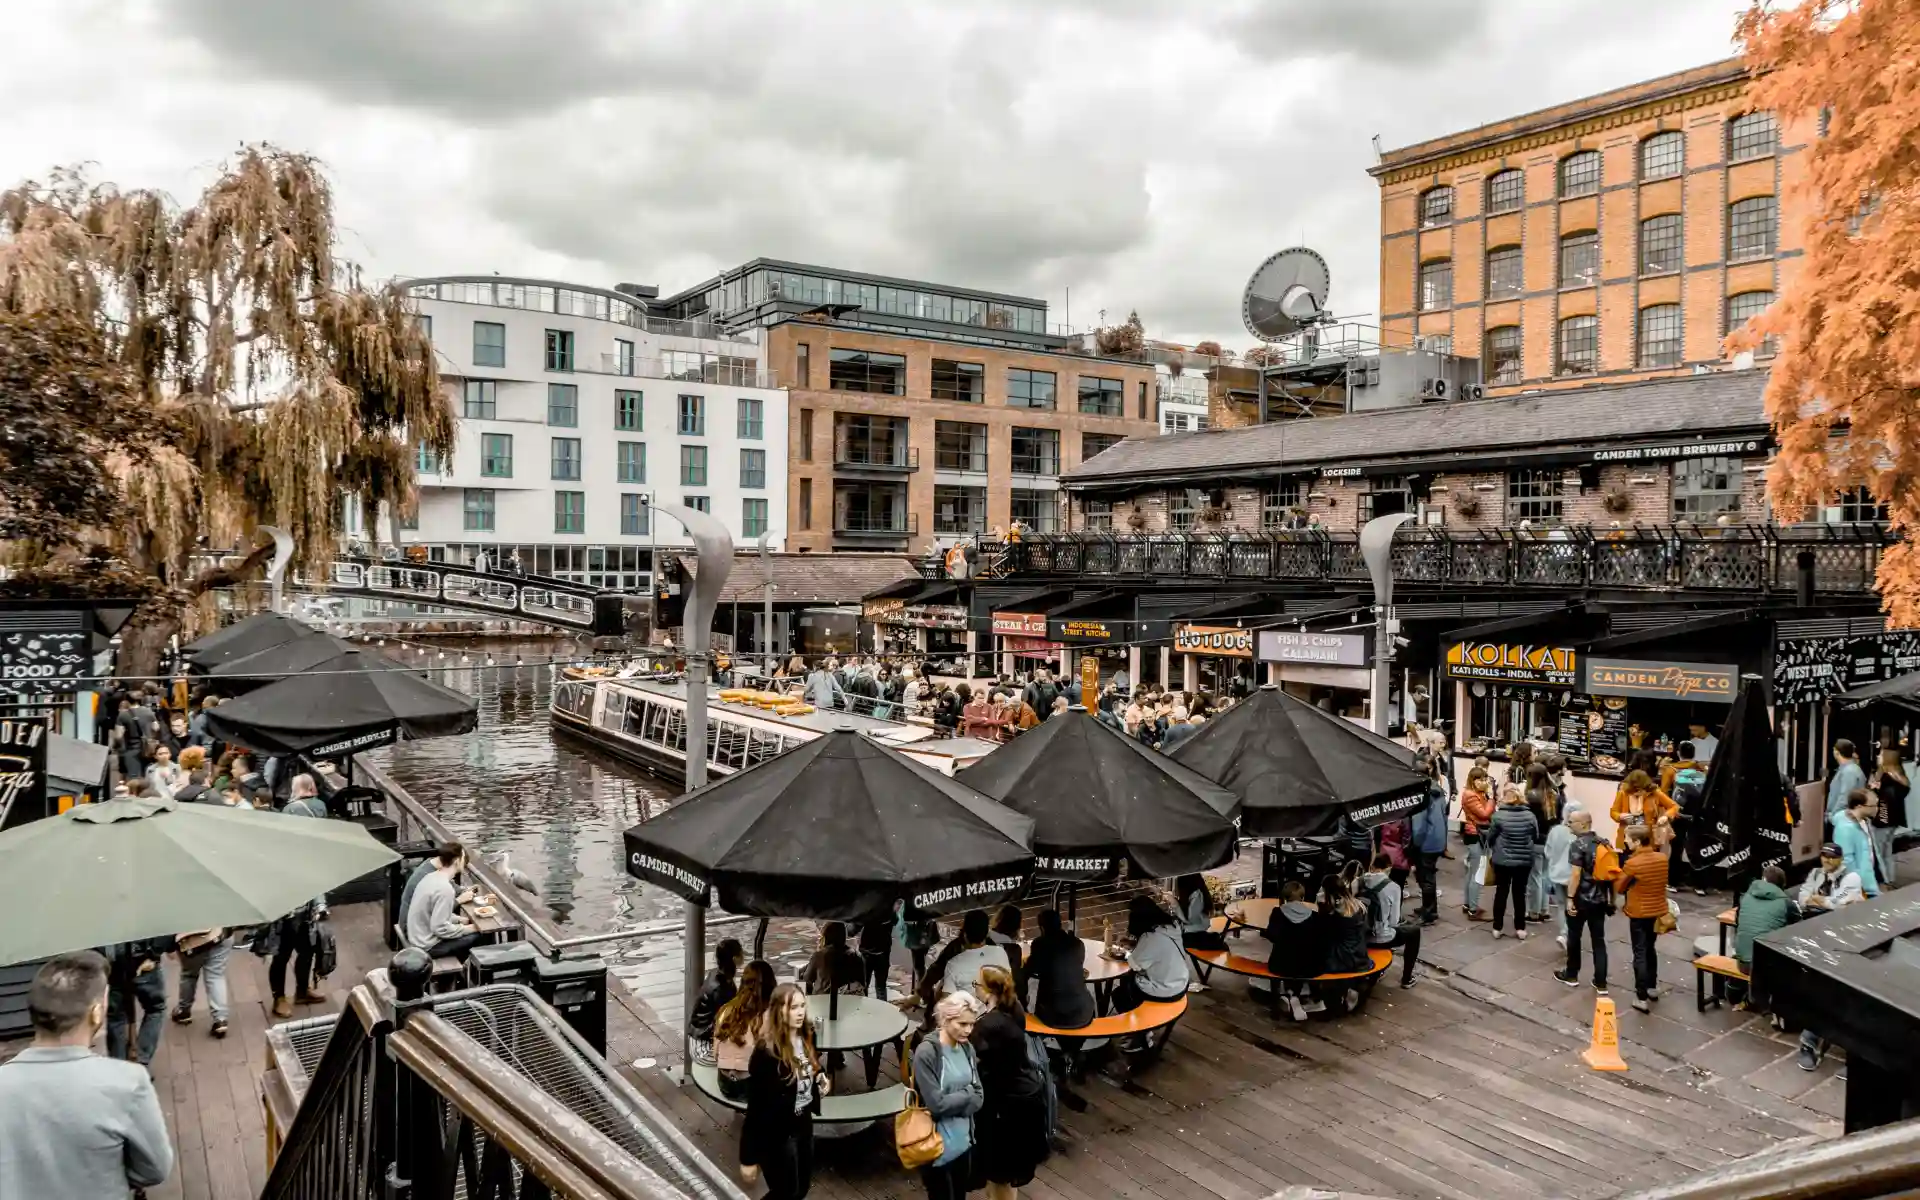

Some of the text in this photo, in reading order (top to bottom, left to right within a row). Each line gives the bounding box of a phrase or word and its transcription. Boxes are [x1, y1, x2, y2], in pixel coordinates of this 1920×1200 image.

[1594, 442, 1744, 460] CAMDEN TOWN BREWERY
[1323, 467, 1361, 477] LOCKSIDE
[995, 620, 1022, 630] STEAK
[1063, 628, 1111, 638] STREET KITCHEN
[1277, 635, 1343, 647] FISH & CHIPS
[1461, 640, 1575, 671] KOLKAT
[3, 664, 55, 678] FOOD
[1452, 665, 1471, 675] KATI
[1472, 667, 1499, 677] ROLLS
[1507, 669, 1533, 679] INDIA
[1787, 663, 1833, 680] WEST YARD
[1592, 671, 1657, 685] CAMDEN
[1706, 678, 1730, 689] CO
[312, 729, 392, 756] CAMDEN MARKET
[1350, 793, 1425, 822] CAMDEN MARKET
[1053, 858, 1110, 870] MARKET
[632, 852, 706, 894] CAMDEN MARKET
[914, 875, 1023, 909] CAMDEN MARKET
